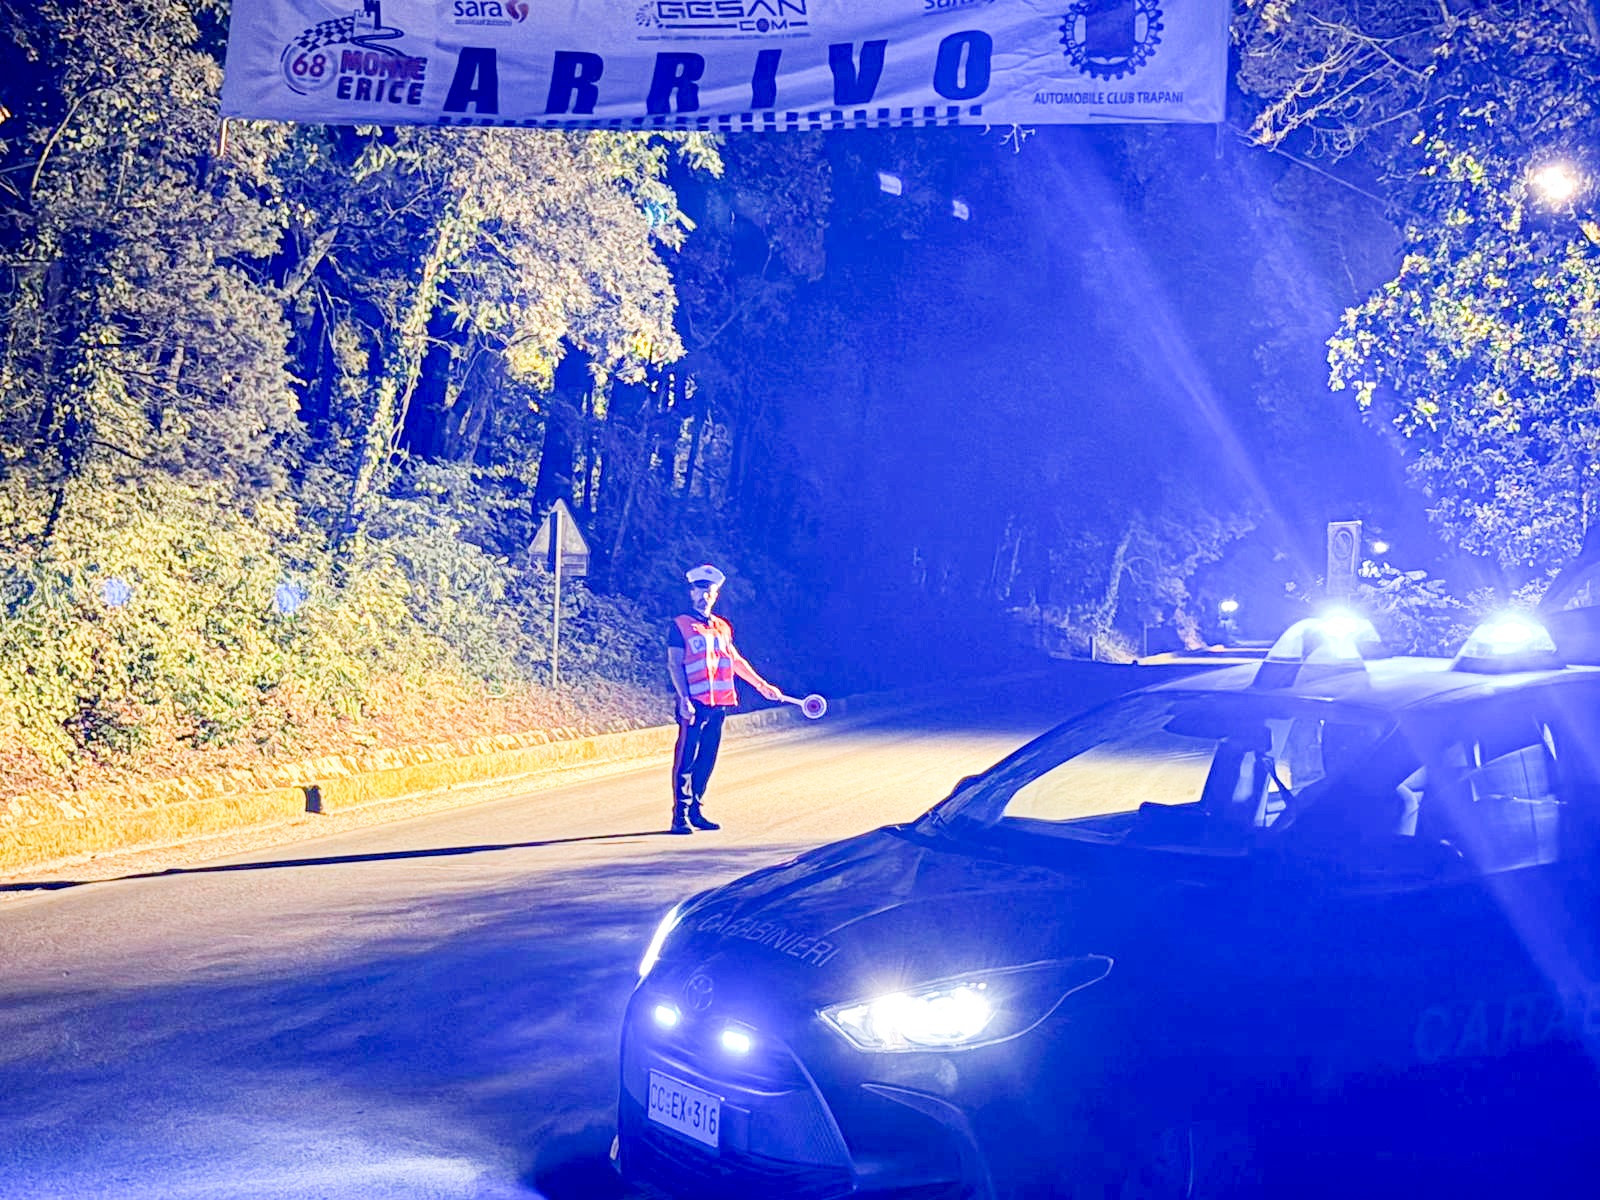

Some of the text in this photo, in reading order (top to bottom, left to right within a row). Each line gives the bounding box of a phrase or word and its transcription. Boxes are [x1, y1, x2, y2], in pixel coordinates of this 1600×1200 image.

[454, 0, 503, 17] sara
[657, 0, 807, 19] GESAN
[739, 18, 788, 33] COM
[292, 52, 326, 78] 68
[443, 30, 993, 116] ARRIVO
[336, 76, 424, 105] ERICE
[1033, 91, 1184, 104] AUTOMOBILE CLUB TRAPANI
[696, 913, 841, 968] CARABINIERI
